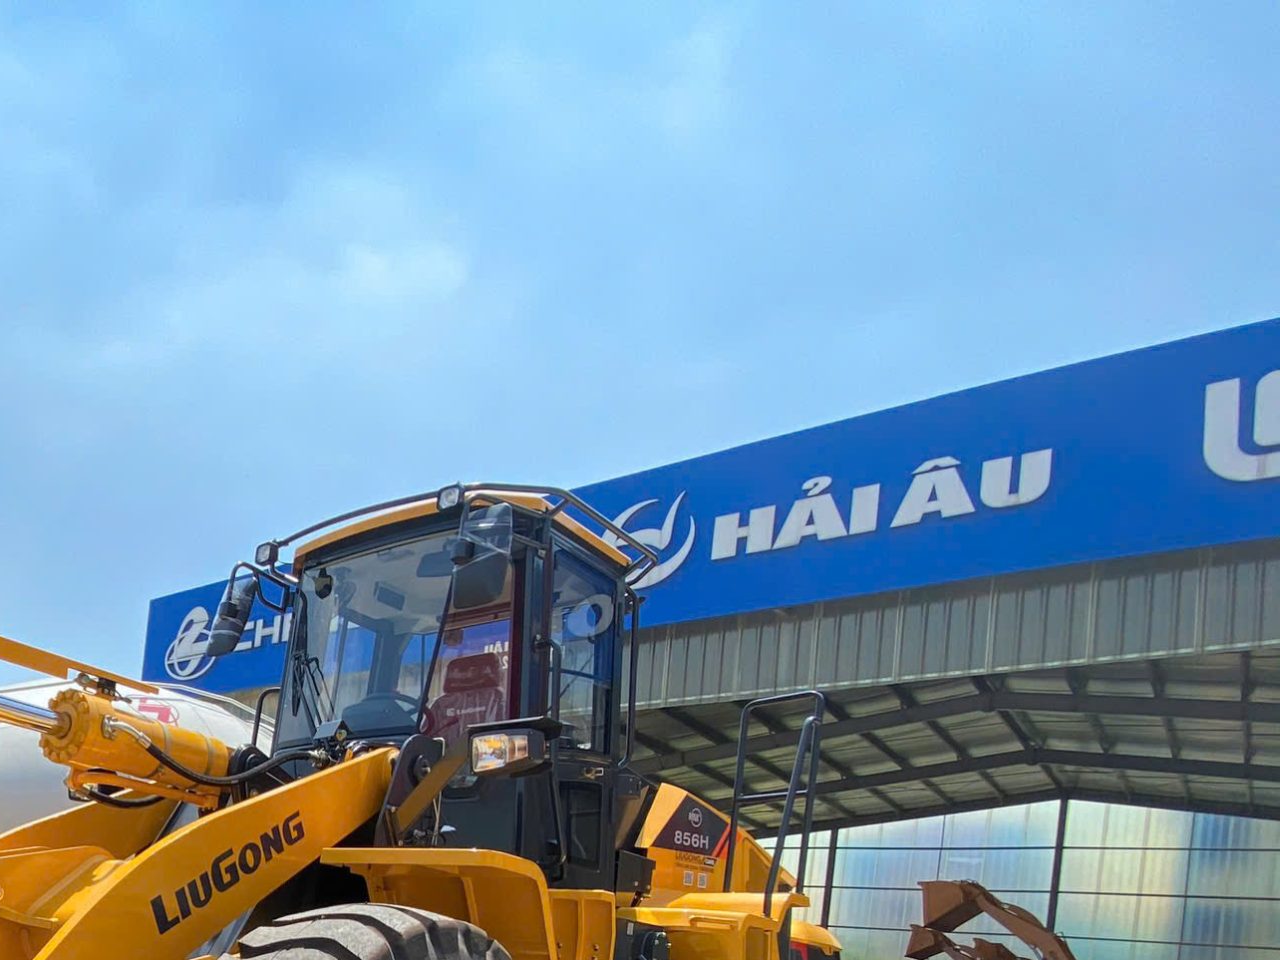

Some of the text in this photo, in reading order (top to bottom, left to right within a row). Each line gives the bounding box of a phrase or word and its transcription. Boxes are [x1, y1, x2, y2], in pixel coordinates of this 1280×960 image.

[711, 448, 1053, 561] HẢI ÂU
[150, 809, 305, 935] LIUGONG
[674, 830, 709, 850] 856H
